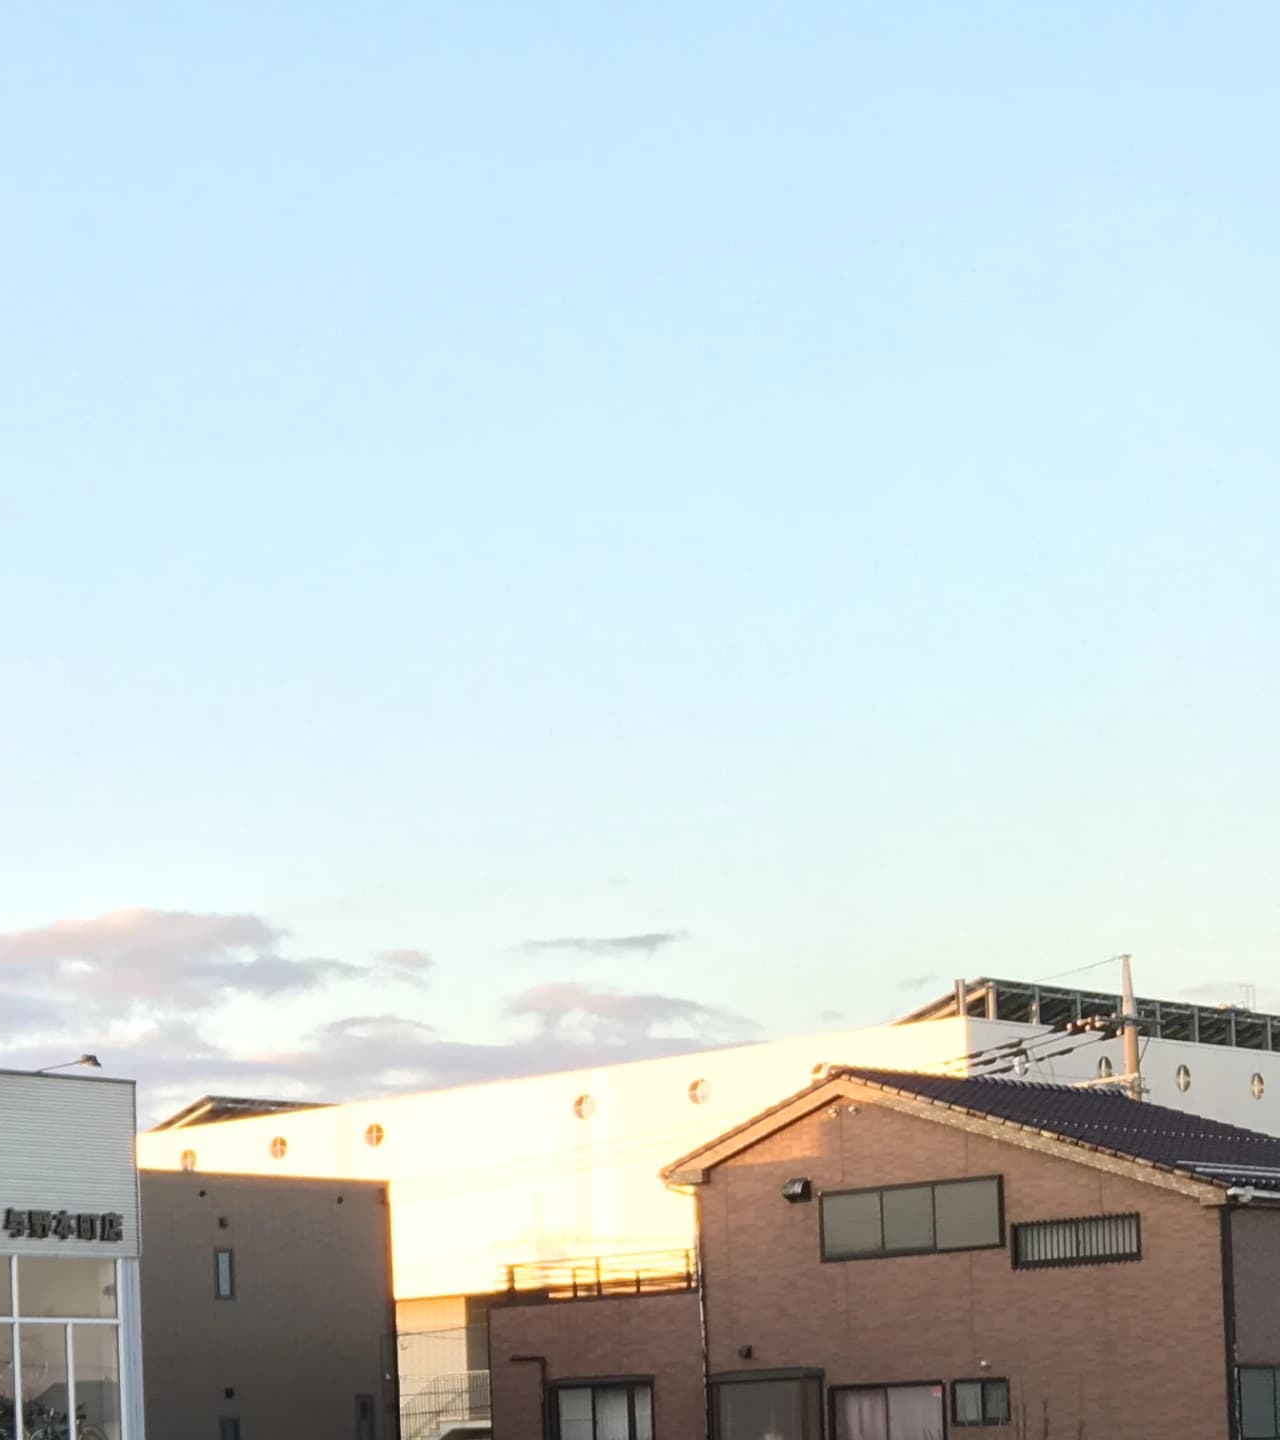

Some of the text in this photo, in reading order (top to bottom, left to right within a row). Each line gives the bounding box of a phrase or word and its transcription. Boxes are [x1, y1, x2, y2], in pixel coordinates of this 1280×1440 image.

[2, 1207, 124, 1242] 与野本町店
